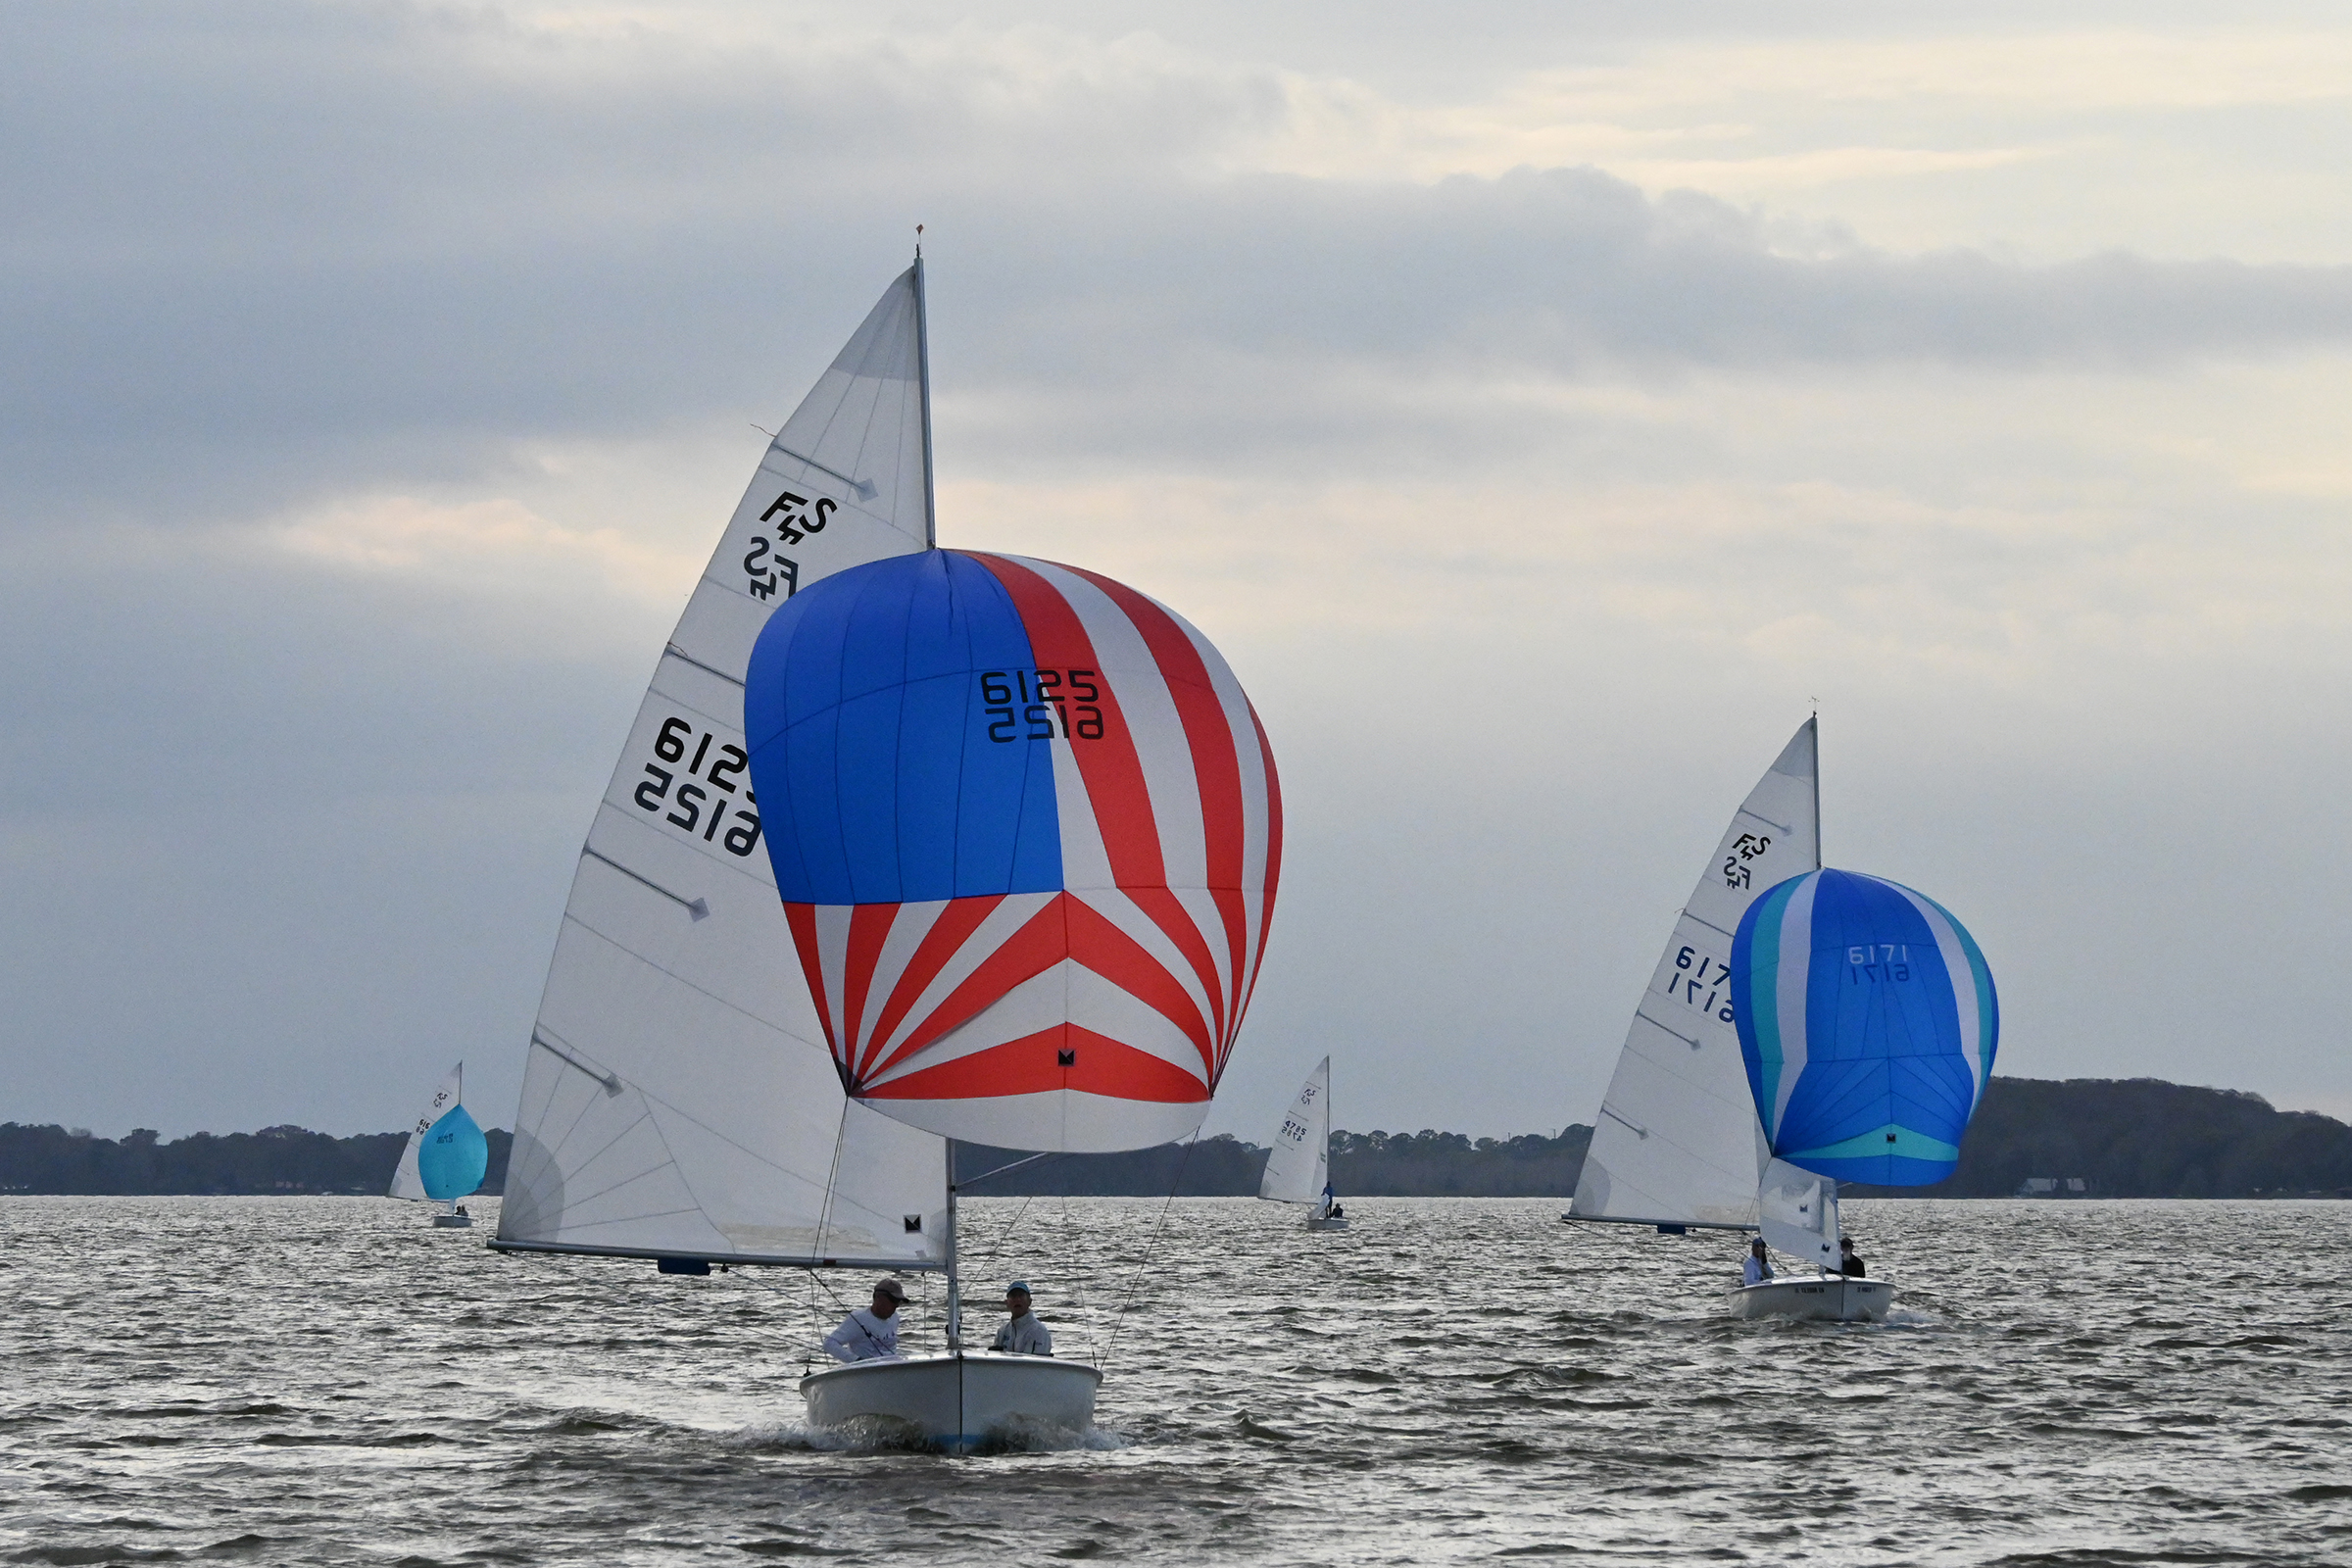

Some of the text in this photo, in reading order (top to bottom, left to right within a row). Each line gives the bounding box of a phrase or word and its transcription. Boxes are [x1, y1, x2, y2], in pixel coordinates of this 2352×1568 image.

[981, 669, 1099, 705] 6125
[655, 717, 756, 804] 612
[1676, 946, 1731, 987] 617
[1848, 944, 1908, 964] 6171
